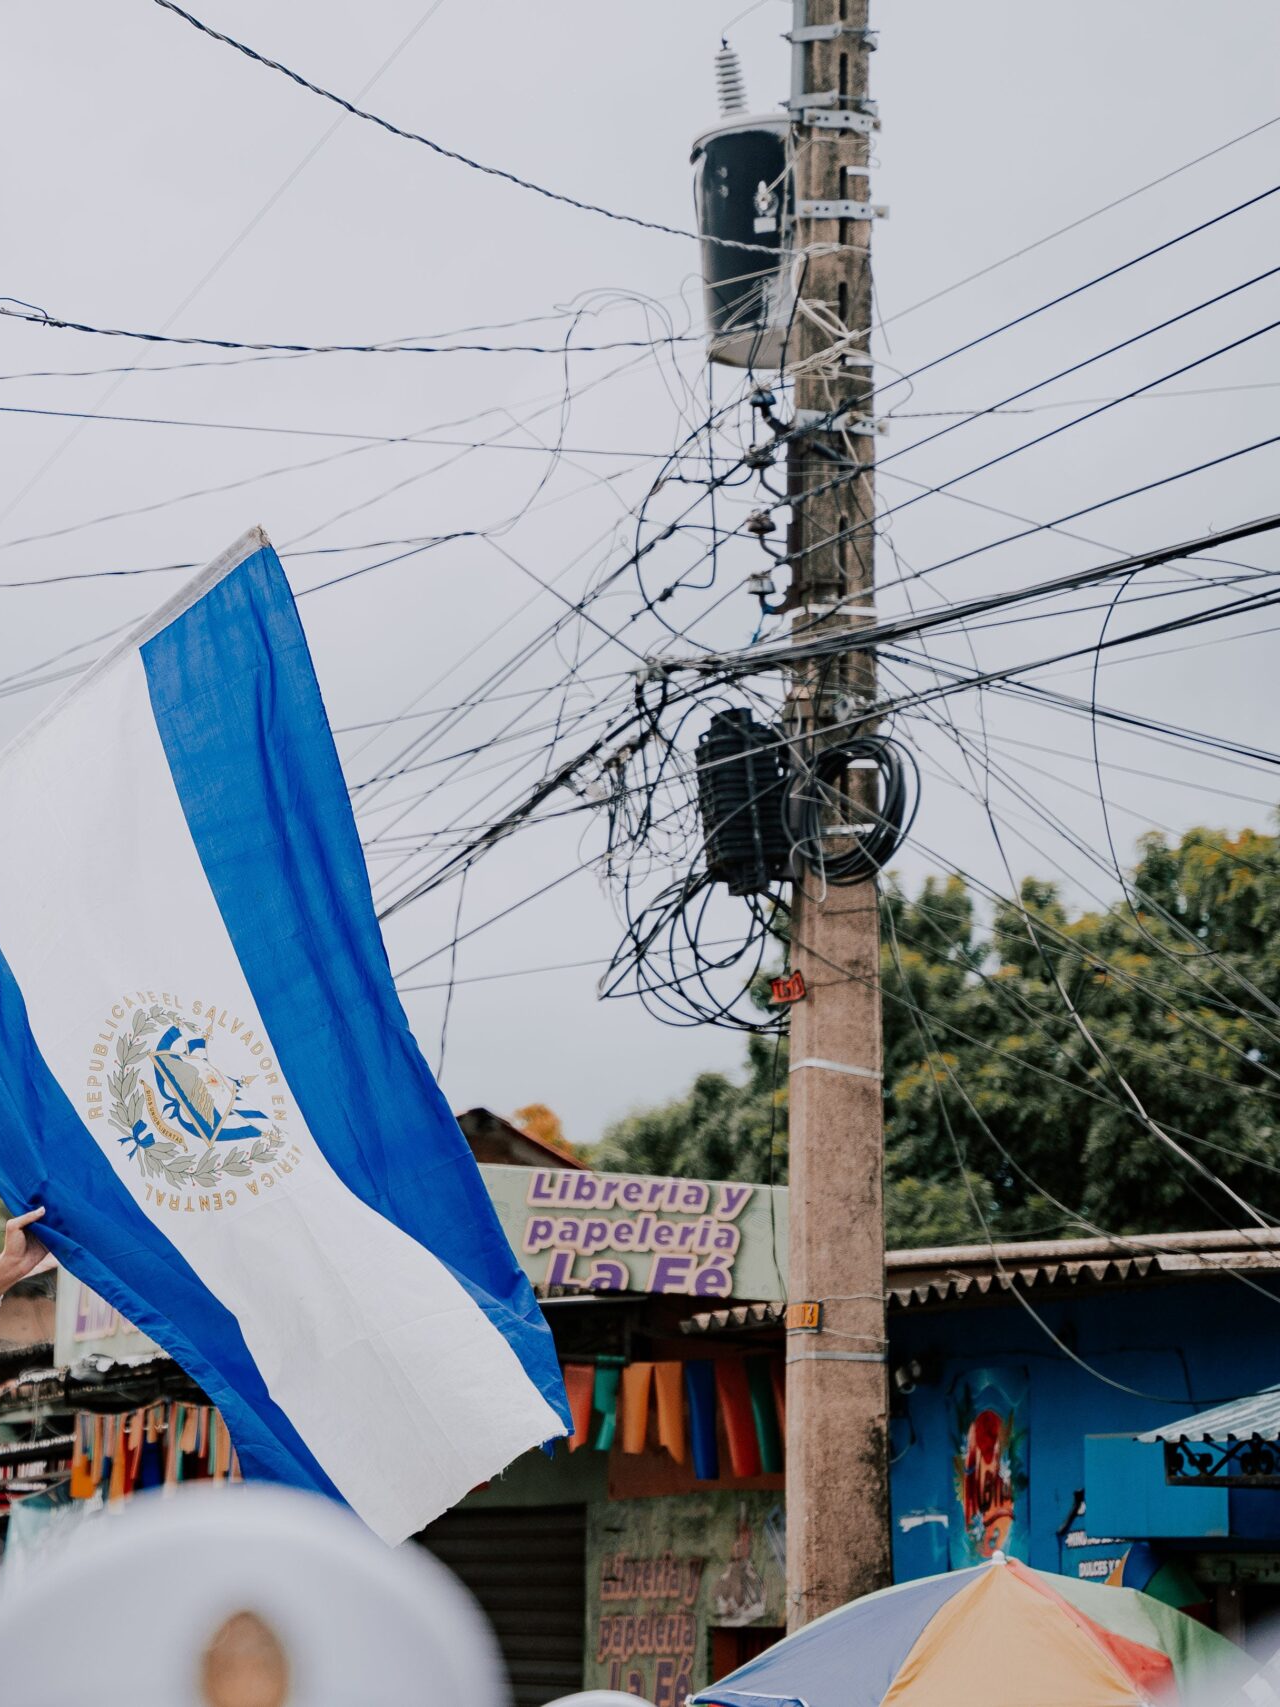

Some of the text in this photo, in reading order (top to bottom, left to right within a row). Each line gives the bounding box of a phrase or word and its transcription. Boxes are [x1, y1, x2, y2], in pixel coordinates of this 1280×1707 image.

[162, 992, 184, 1010] EL
[87, 995, 137, 1120] REPUBLICA
[192, 1000, 279, 1086] SALVADOR
[271, 1094, 288, 1121] EN
[145, 1183, 238, 1212] CENTRAL
[718, 1186, 748, 1213] y
[527, 1217, 736, 1250] papeleria
[549, 1252, 726, 1297] La Fé
